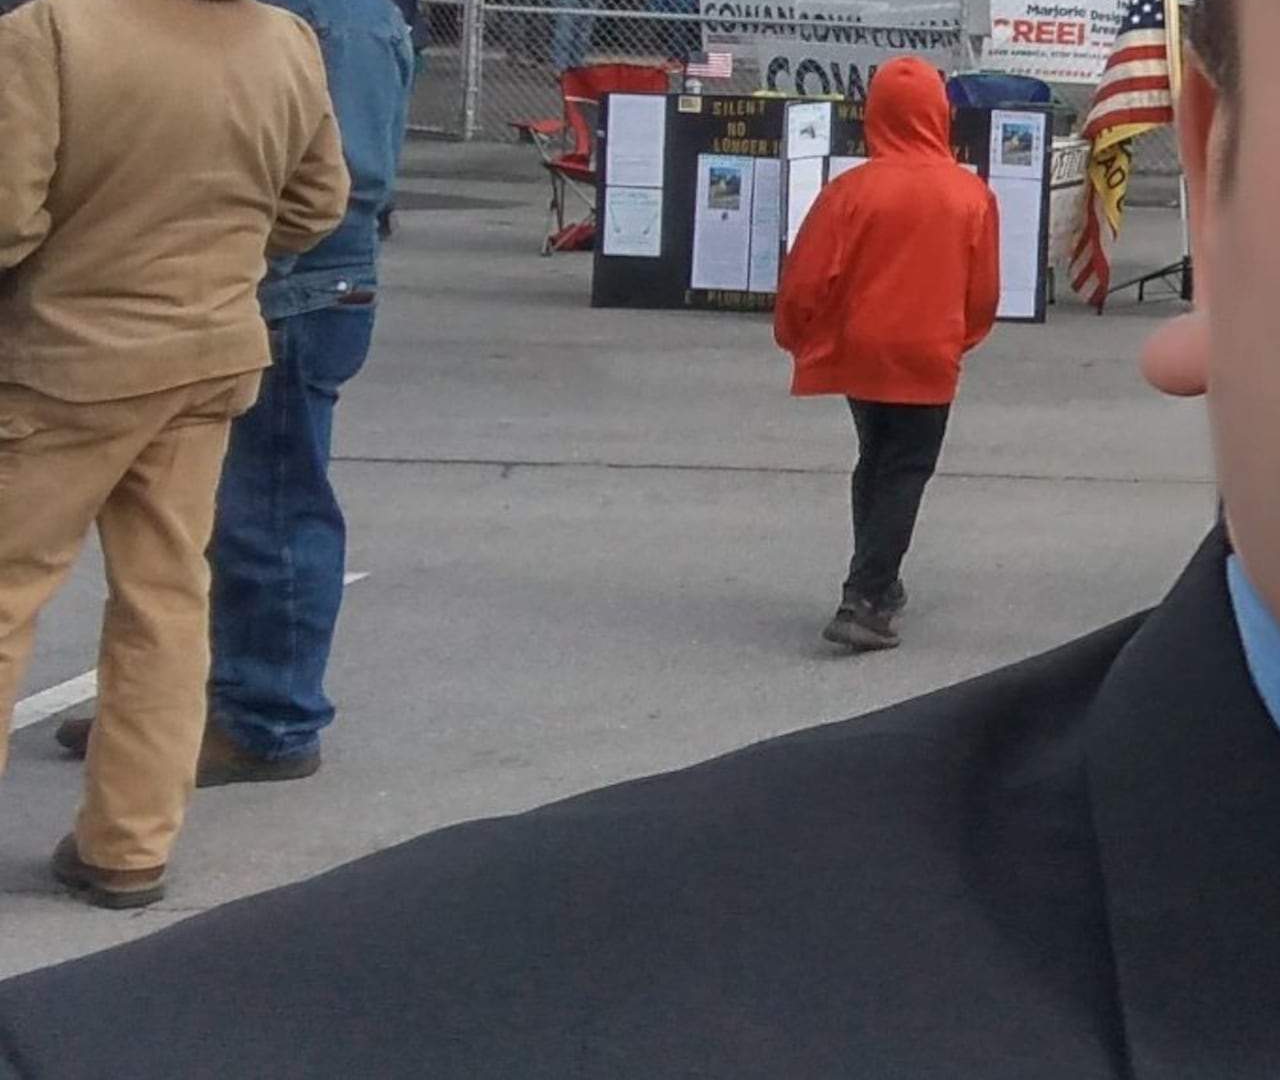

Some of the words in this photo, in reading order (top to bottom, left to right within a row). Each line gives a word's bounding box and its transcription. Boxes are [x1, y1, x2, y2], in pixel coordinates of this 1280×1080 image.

[704, 2, 796, 36] COWAN
[1027, 3, 1087, 19] Marjorie
[798, 12, 869, 44] COWA
[712, 100, 766, 116] SILENT
[727, 122, 746, 137] NO
